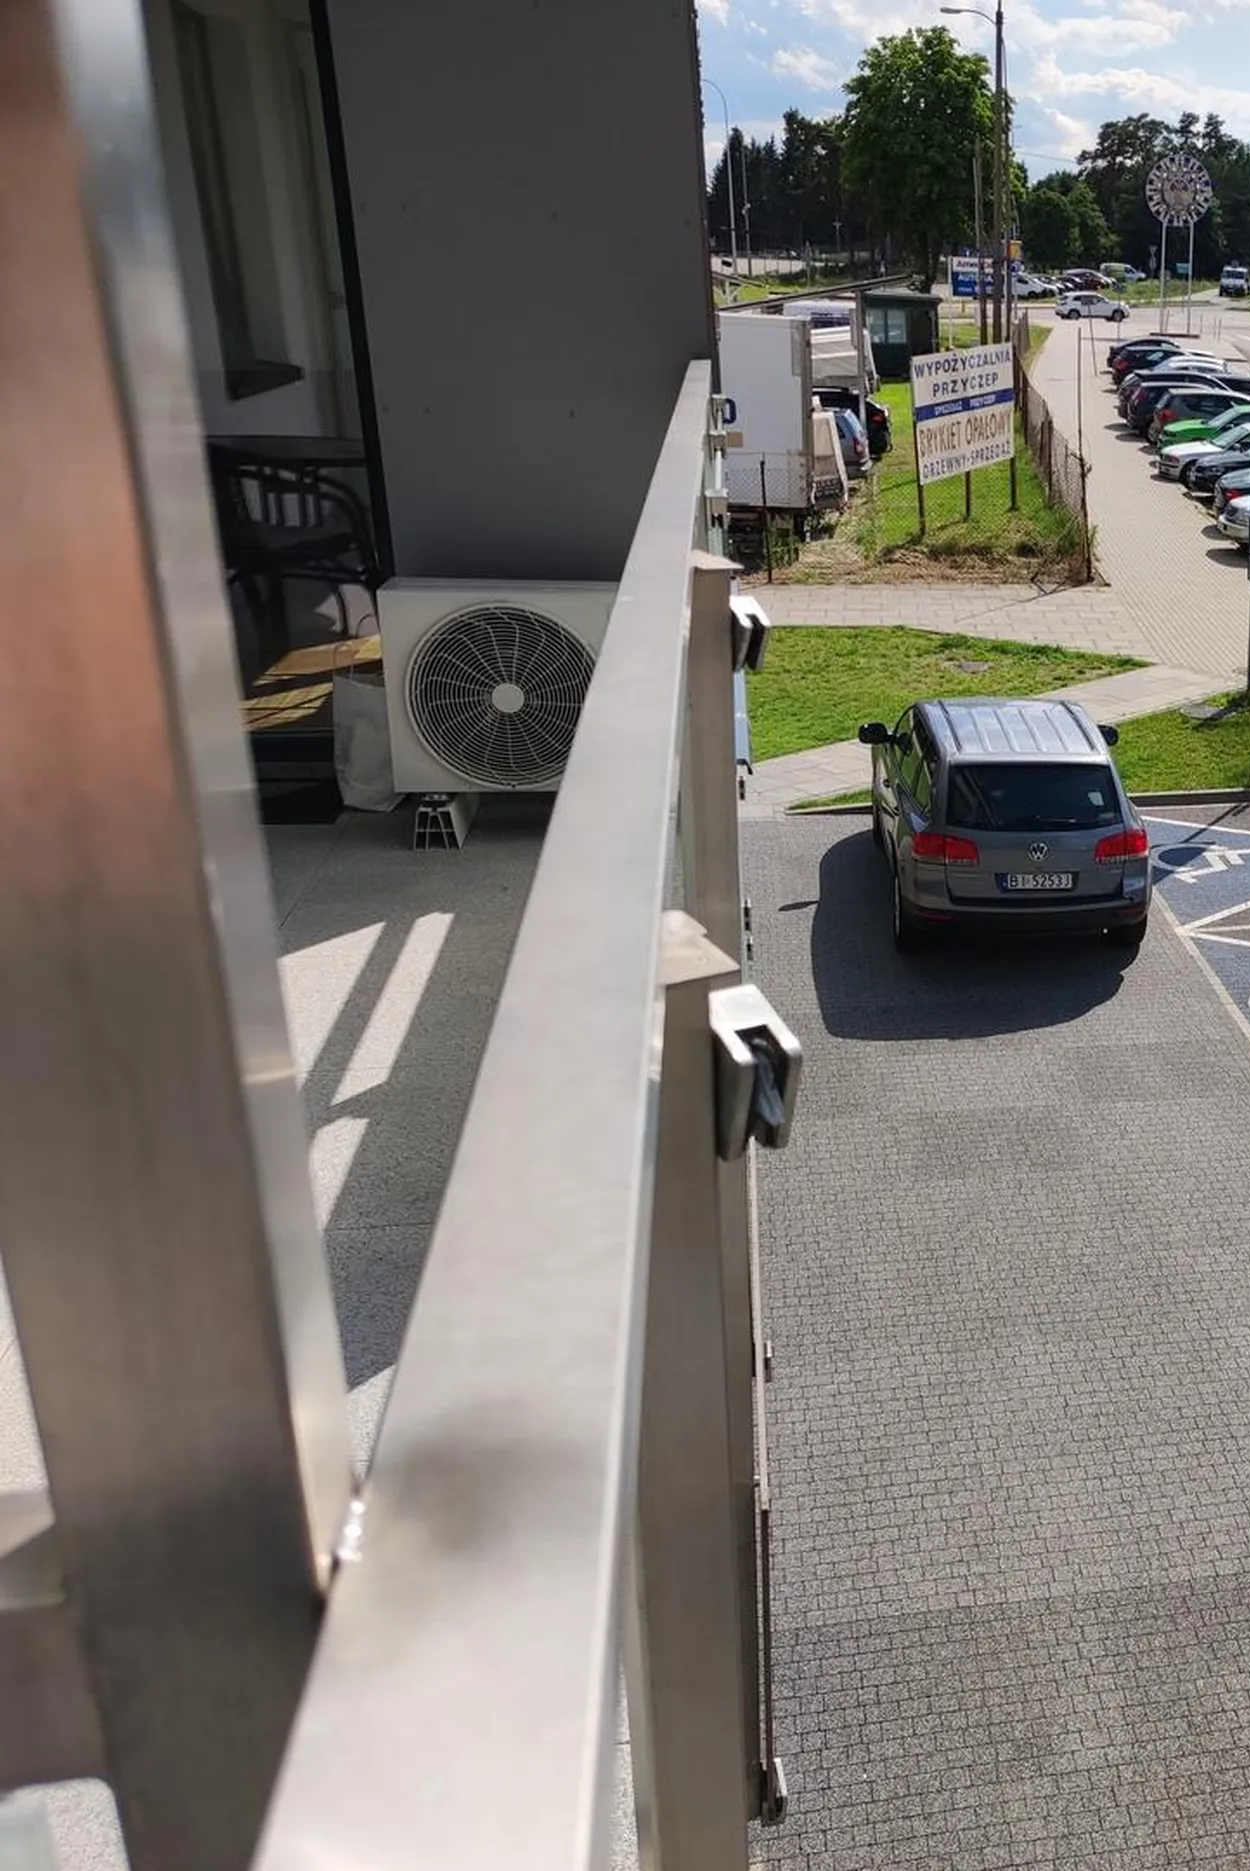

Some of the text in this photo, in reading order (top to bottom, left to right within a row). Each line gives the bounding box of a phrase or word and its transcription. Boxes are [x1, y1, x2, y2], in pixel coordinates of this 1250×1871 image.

[914, 349, 1011, 379] WYPOŻYCZALNIA
[932, 371, 999, 397] PRZYCZEP
[919, 420, 963, 458] BRYKIET
[1010, 874, 1026, 887] BI
